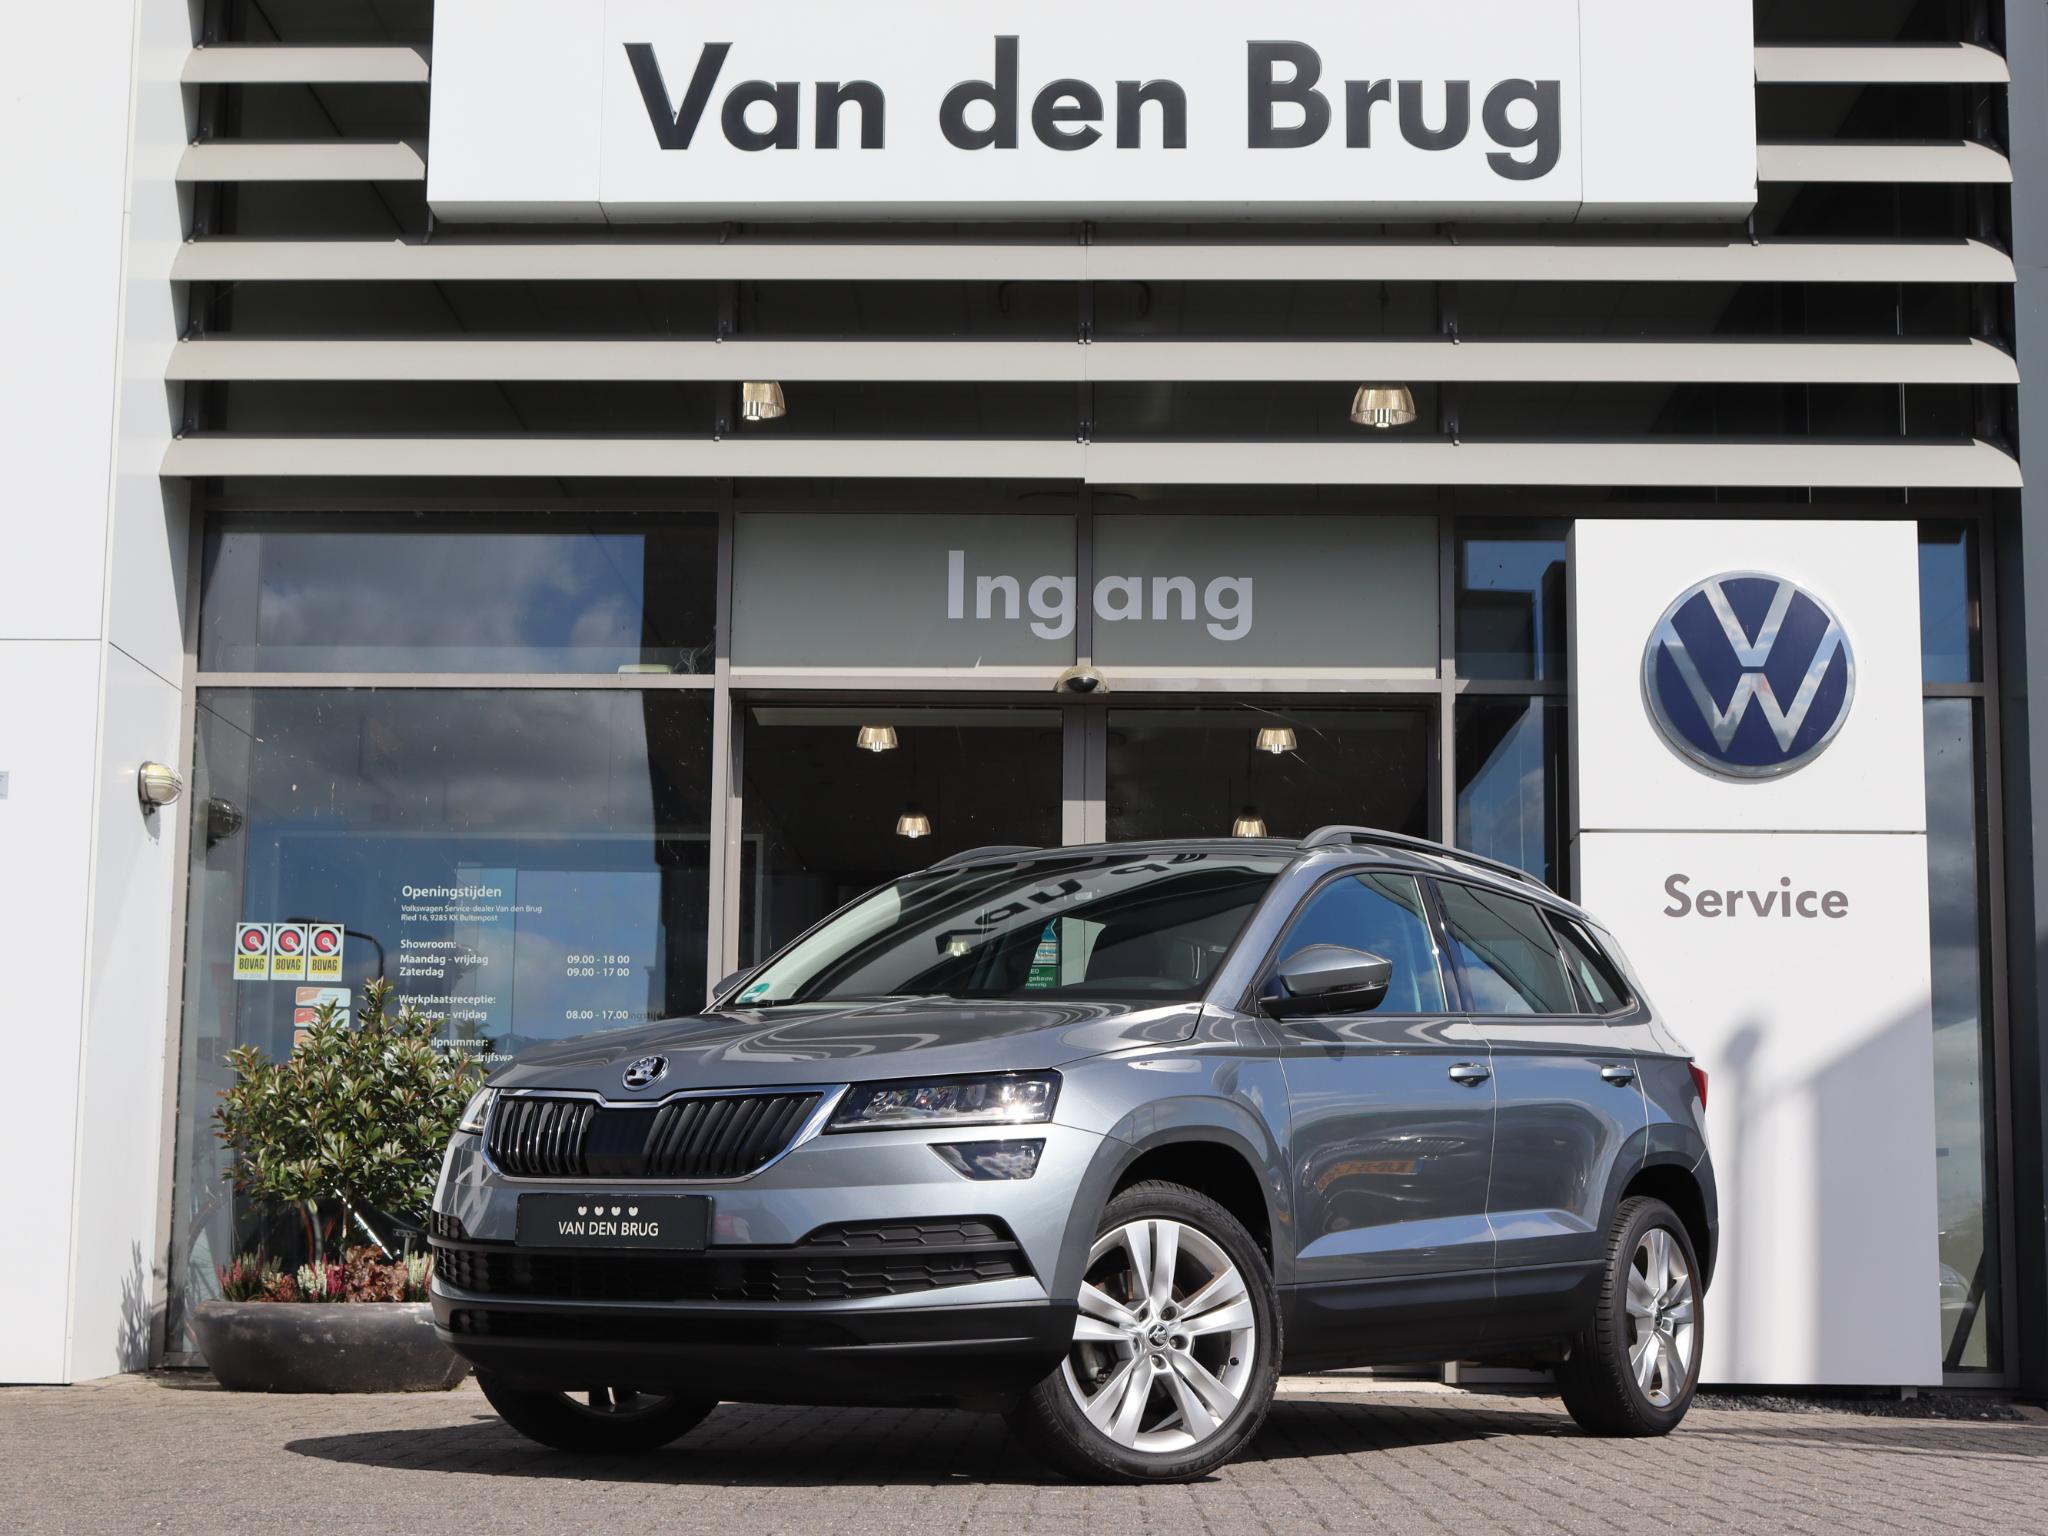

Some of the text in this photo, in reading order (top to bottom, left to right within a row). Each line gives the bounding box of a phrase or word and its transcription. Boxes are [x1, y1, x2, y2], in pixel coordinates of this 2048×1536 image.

[622, 34, 1562, 181] Van den Brug
[947, 550, 1254, 641] Ingang
[402, 885, 502, 899] Openingstijden
[1663, 874, 1849, 919] Service
[401, 904, 543, 913] Volkswagen Service-dealer Van den Brug
[400, 939, 457, 949] Showroom:
[239, 958, 265, 970] BOVAG
[276, 959, 301, 970] BOVAG
[312, 959, 338, 971] BOVAG
[400, 954, 446, 966] Maandag
[454, 954, 489, 966] vrijdag
[567, 955, 595, 964] 09.00
[400, 966, 444, 978] Zaterdag
[566, 967, 594, 976] 09.00
[398, 994, 496, 1006] Werkplaatsreceptie:
[452, 1009, 488, 1021] vrijdag
[566, 1010, 593, 1019] 08.00
[602, 1010, 629, 1019] 17.00
[558, 1221, 659, 1237] VAN DEN BRUG
